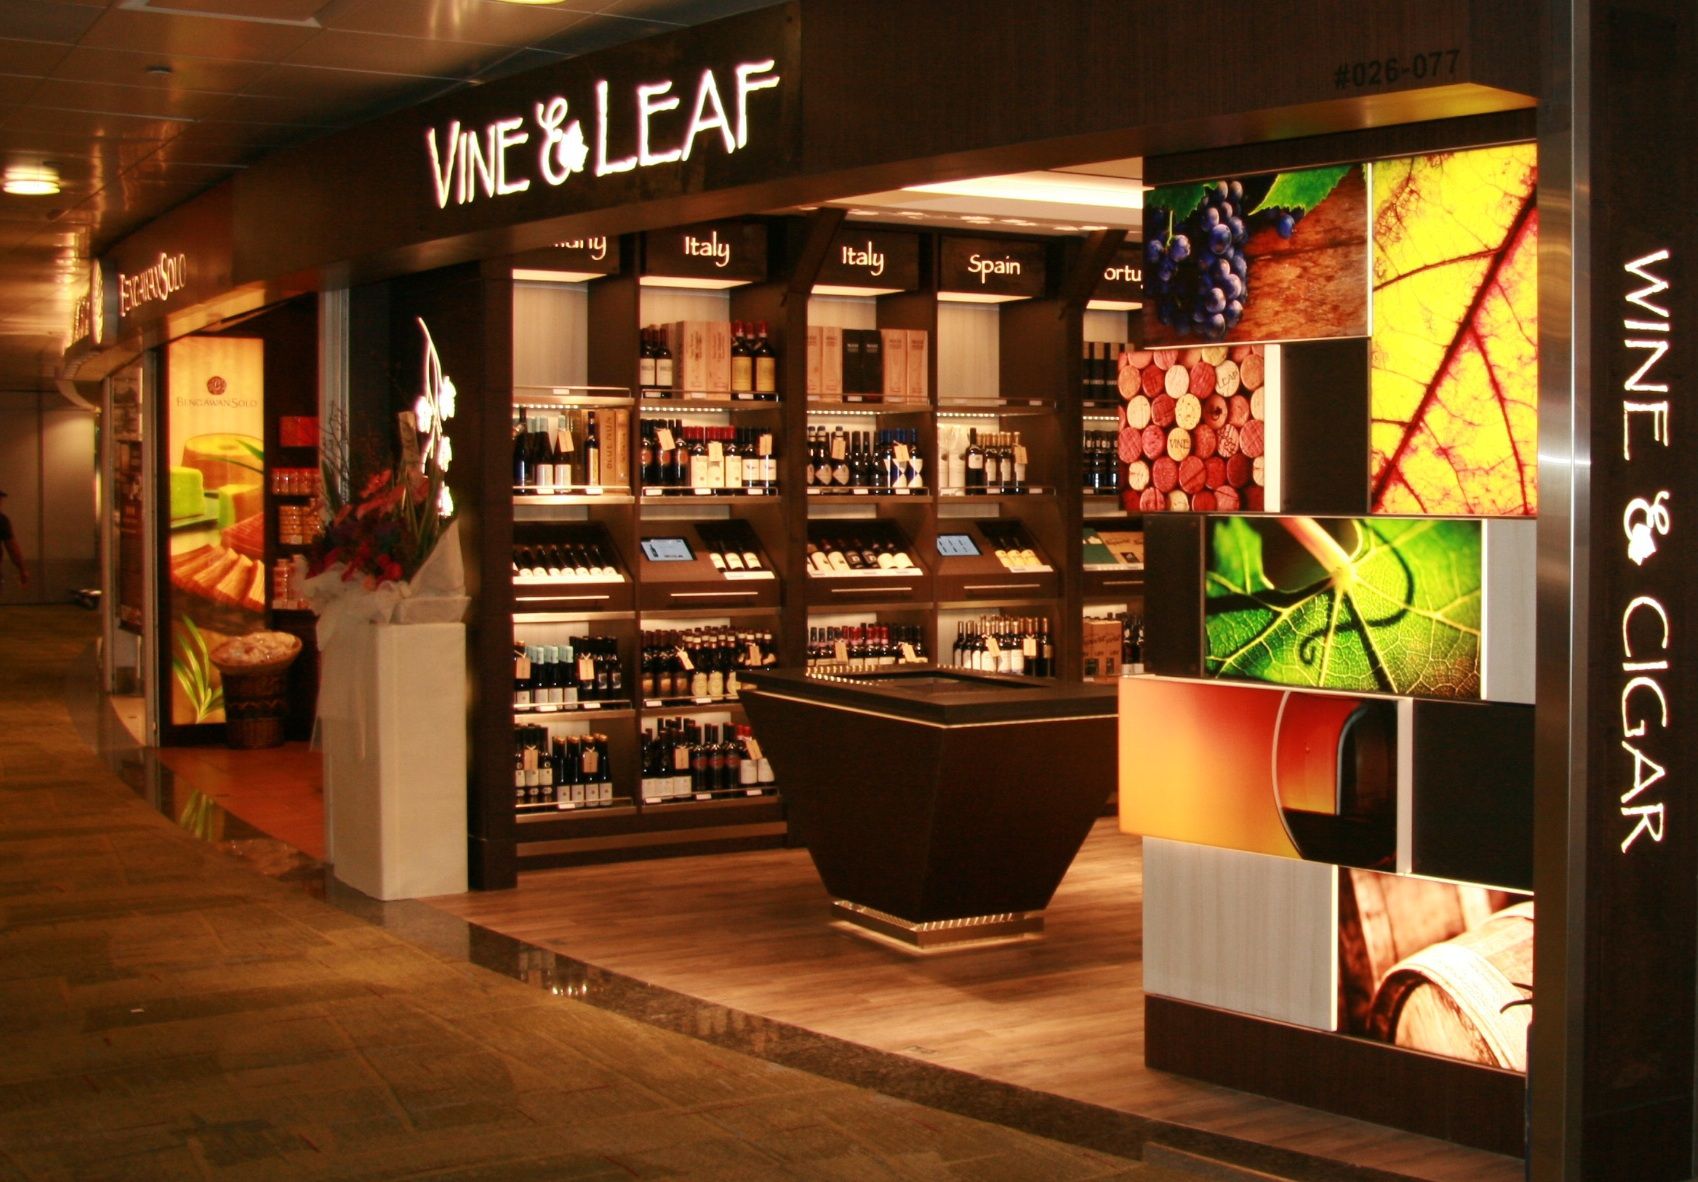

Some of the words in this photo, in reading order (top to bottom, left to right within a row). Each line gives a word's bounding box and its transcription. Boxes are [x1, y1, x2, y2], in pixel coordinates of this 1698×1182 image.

[1334, 49, 1460, 89] #026-077
[427, 116, 531, 209] VINE
[595, 59, 780, 178] LEAF
[684, 230, 730, 268] Italy
[842, 240, 885, 277] Italy
[967, 253, 1021, 284] Spain
[1103, 264, 1144, 289] ortu
[1623, 249, 1671, 461] WINE
[1169, 438, 1190, 450] VINE
[1620, 595, 1669, 854] CIGAR
